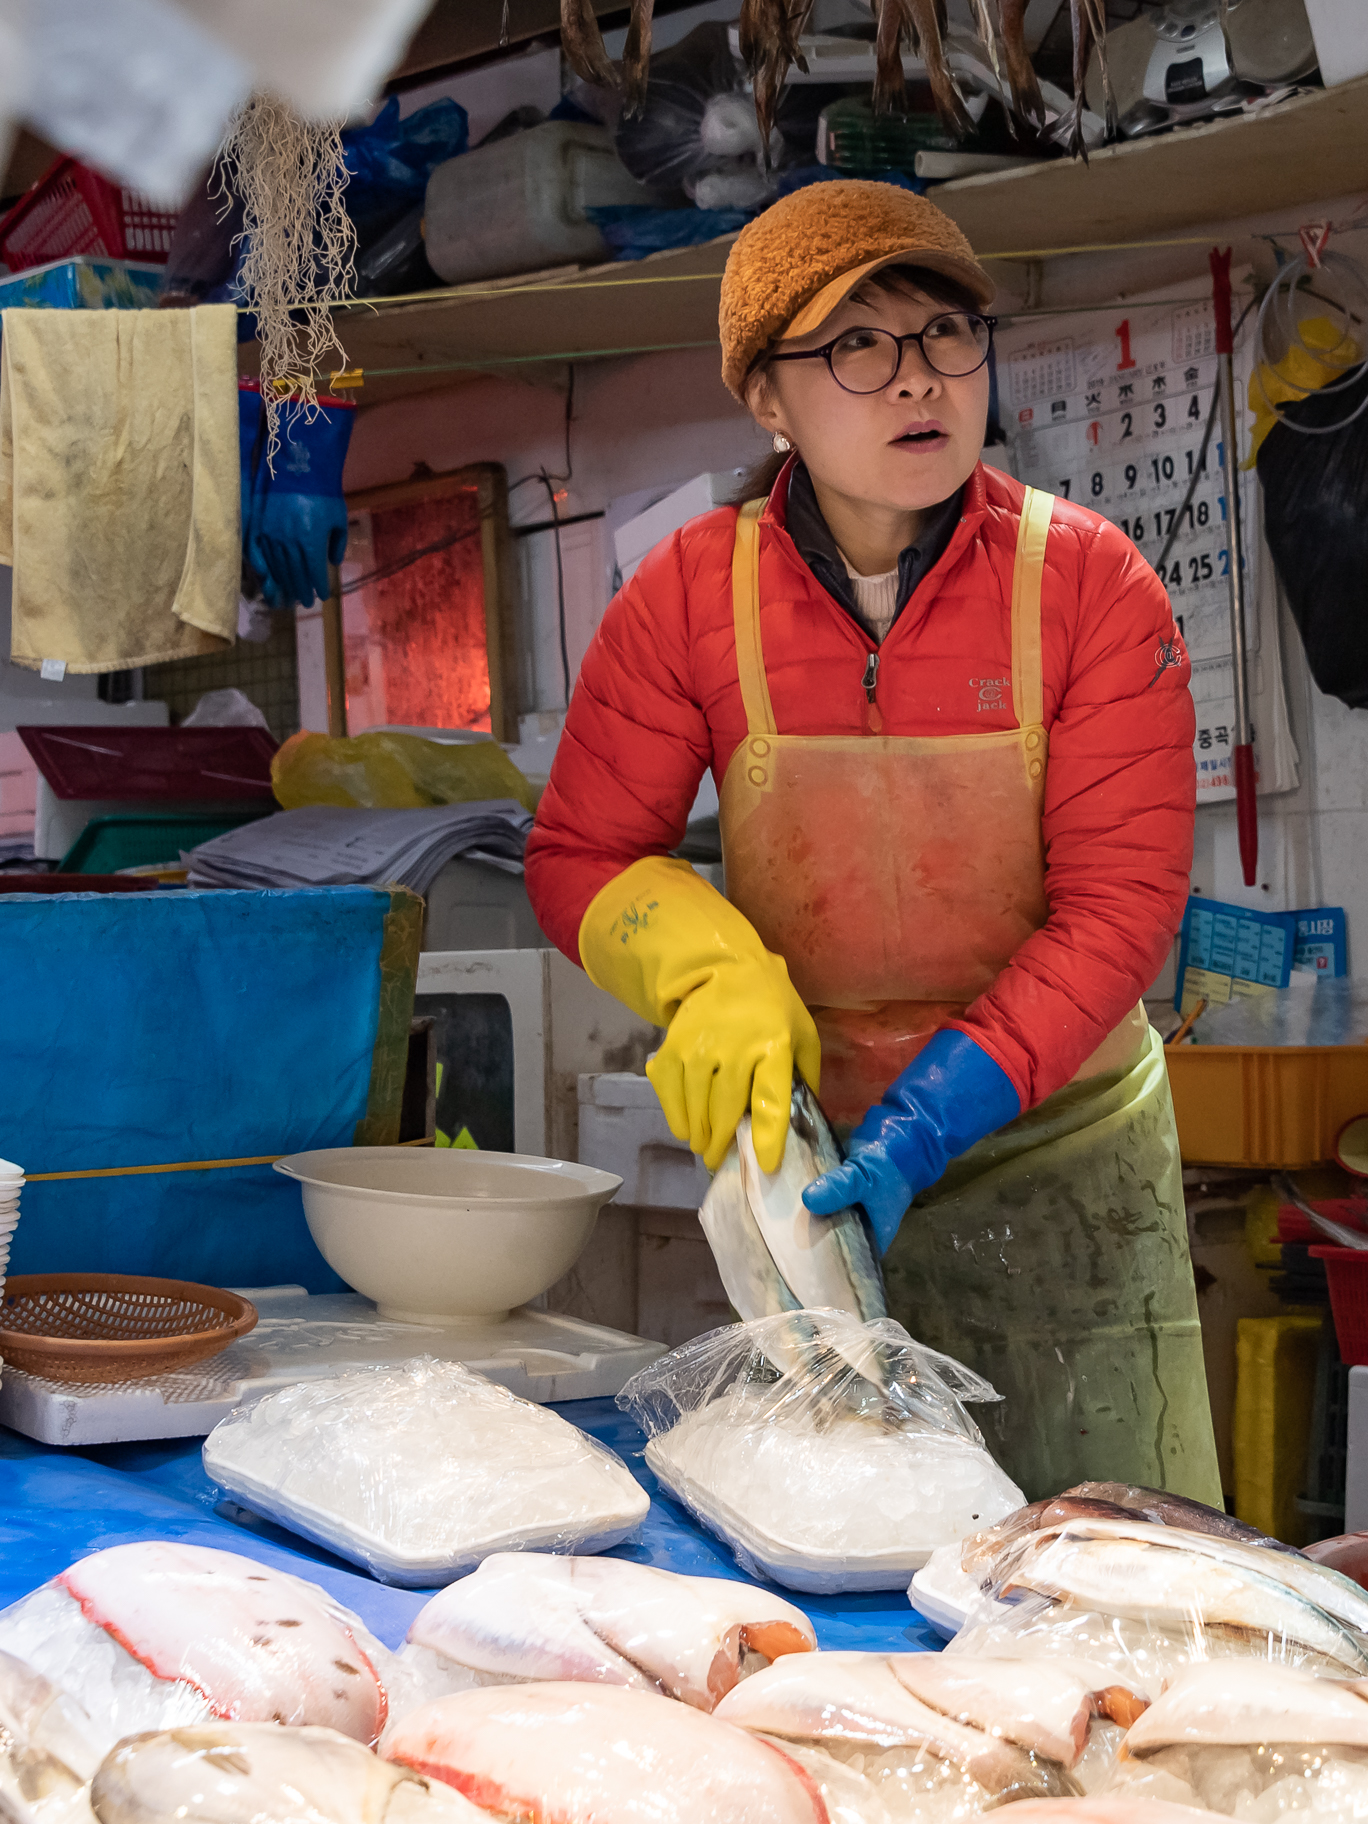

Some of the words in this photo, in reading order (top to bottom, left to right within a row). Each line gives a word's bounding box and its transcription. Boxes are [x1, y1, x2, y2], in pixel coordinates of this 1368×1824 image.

[1115, 319, 1136, 371] 1
[1120, 412, 1133, 440] 2
[1154, 403, 1166, 429] 3
[1188, 395, 1200, 420] 4
[1059, 479, 1071, 500] 7
[1091, 472, 1103, 497] 8
[1124, 464, 1137, 489] 9
[1151, 456, 1174, 484] 10
[1121, 515, 1144, 541] 16
[1154, 507, 1177, 536] 17
[1186, 501, 1209, 529] 18
[1189, 553, 1213, 583] 25
[968, 676, 1011, 688] Crack
[976, 699, 1007, 713] jack
